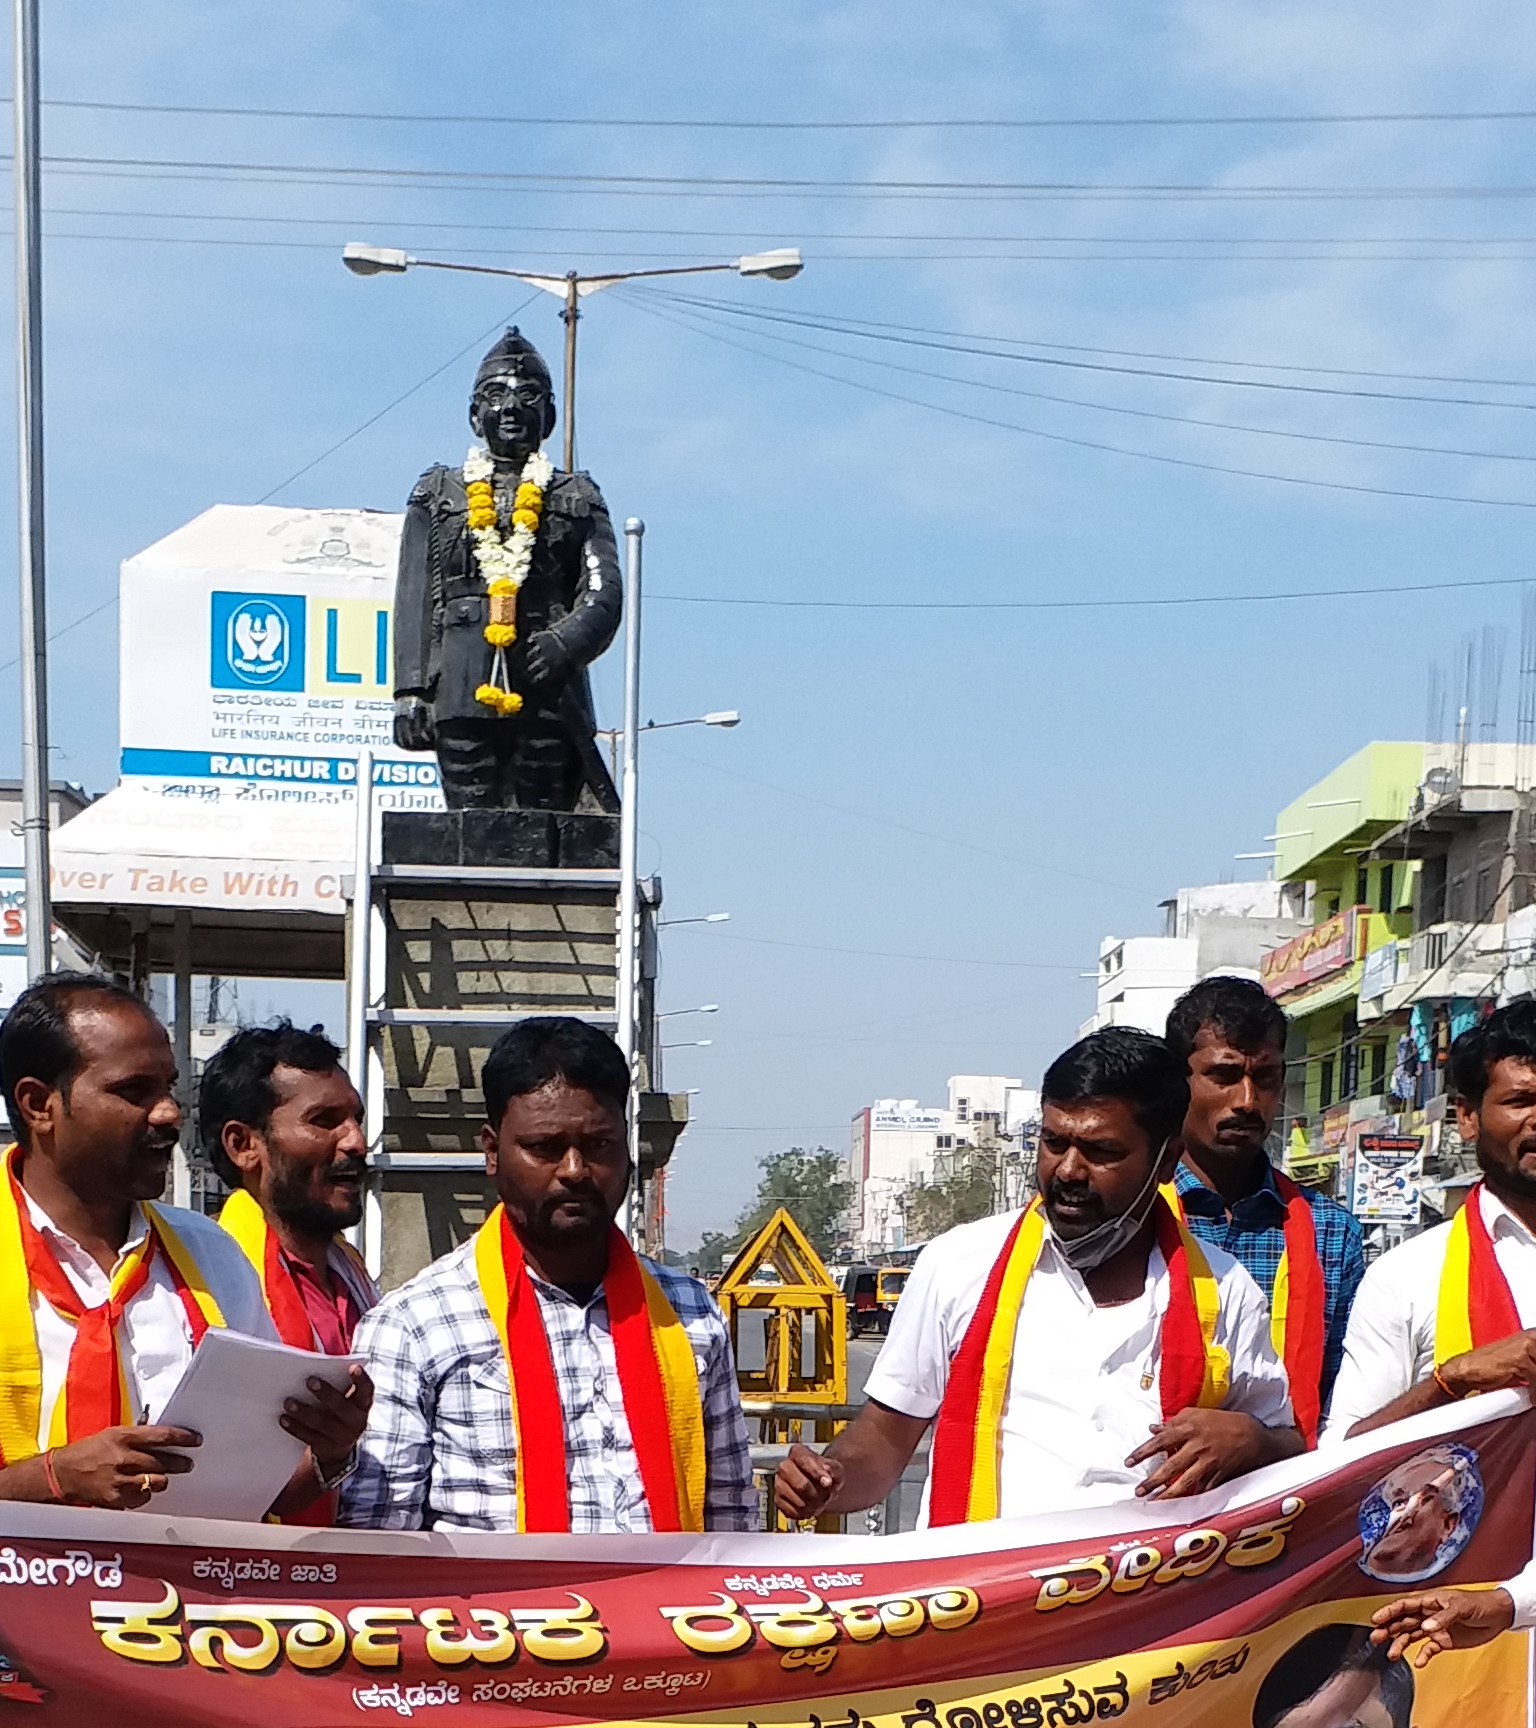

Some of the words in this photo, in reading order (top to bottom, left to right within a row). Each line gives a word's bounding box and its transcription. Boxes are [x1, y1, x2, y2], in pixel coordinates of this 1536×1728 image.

[211, 727, 236, 739] LIFE
[240, 729, 310, 743] INSURANCE
[313, 732, 396, 747] CORPORATIO
[209, 755, 331, 780] RAICHUR
[128, 869, 209, 895] Take
[223, 870, 299, 898] With
[90, 1577, 609, 1673] ಕರ್ನಾಟಕ
[659, 1585, 985, 1675] ರಕ್ಷಣಾ
[1028, 1496, 1307, 1612] ವೇದಿಕೆ
[192, 1557, 281, 1589] ಕನ್ನಡವೇ
[290, 1562, 339, 1584] ಜಾತಿ
[811, 1570, 865, 1592] ಧರ್ಮ
[352, 1682, 460, 1717] (ಕನ್ನಡವೇ
[471, 1676, 614, 1703] ಸಂಘಟನೆಗಳ
[622, 1669, 712, 1696] ಒಕ್ಕೂಟ)
